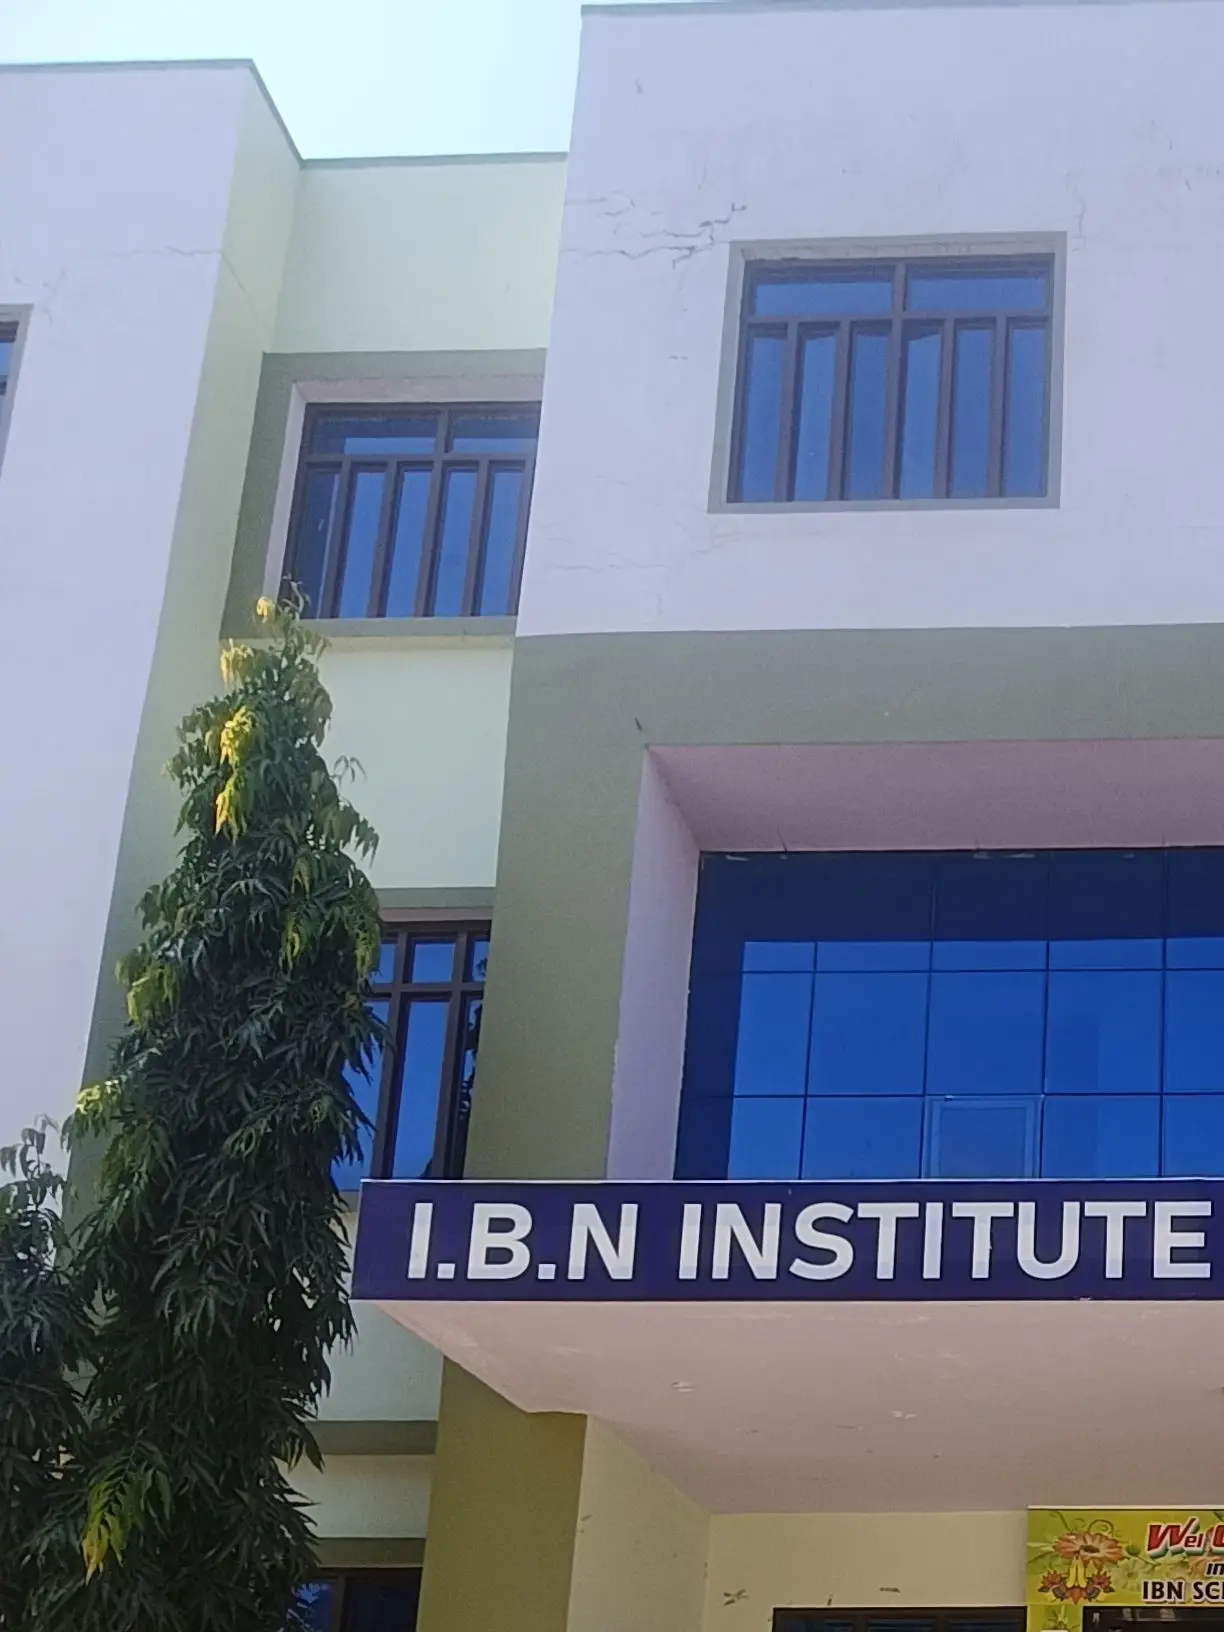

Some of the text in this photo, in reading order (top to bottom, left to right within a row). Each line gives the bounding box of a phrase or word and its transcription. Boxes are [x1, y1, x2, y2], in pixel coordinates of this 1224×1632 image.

[407, 1203, 638, 1280] I.B.N
[678, 1200, 1213, 1280] INSTITUTE
[1142, 1580, 1184, 1601] IBN
